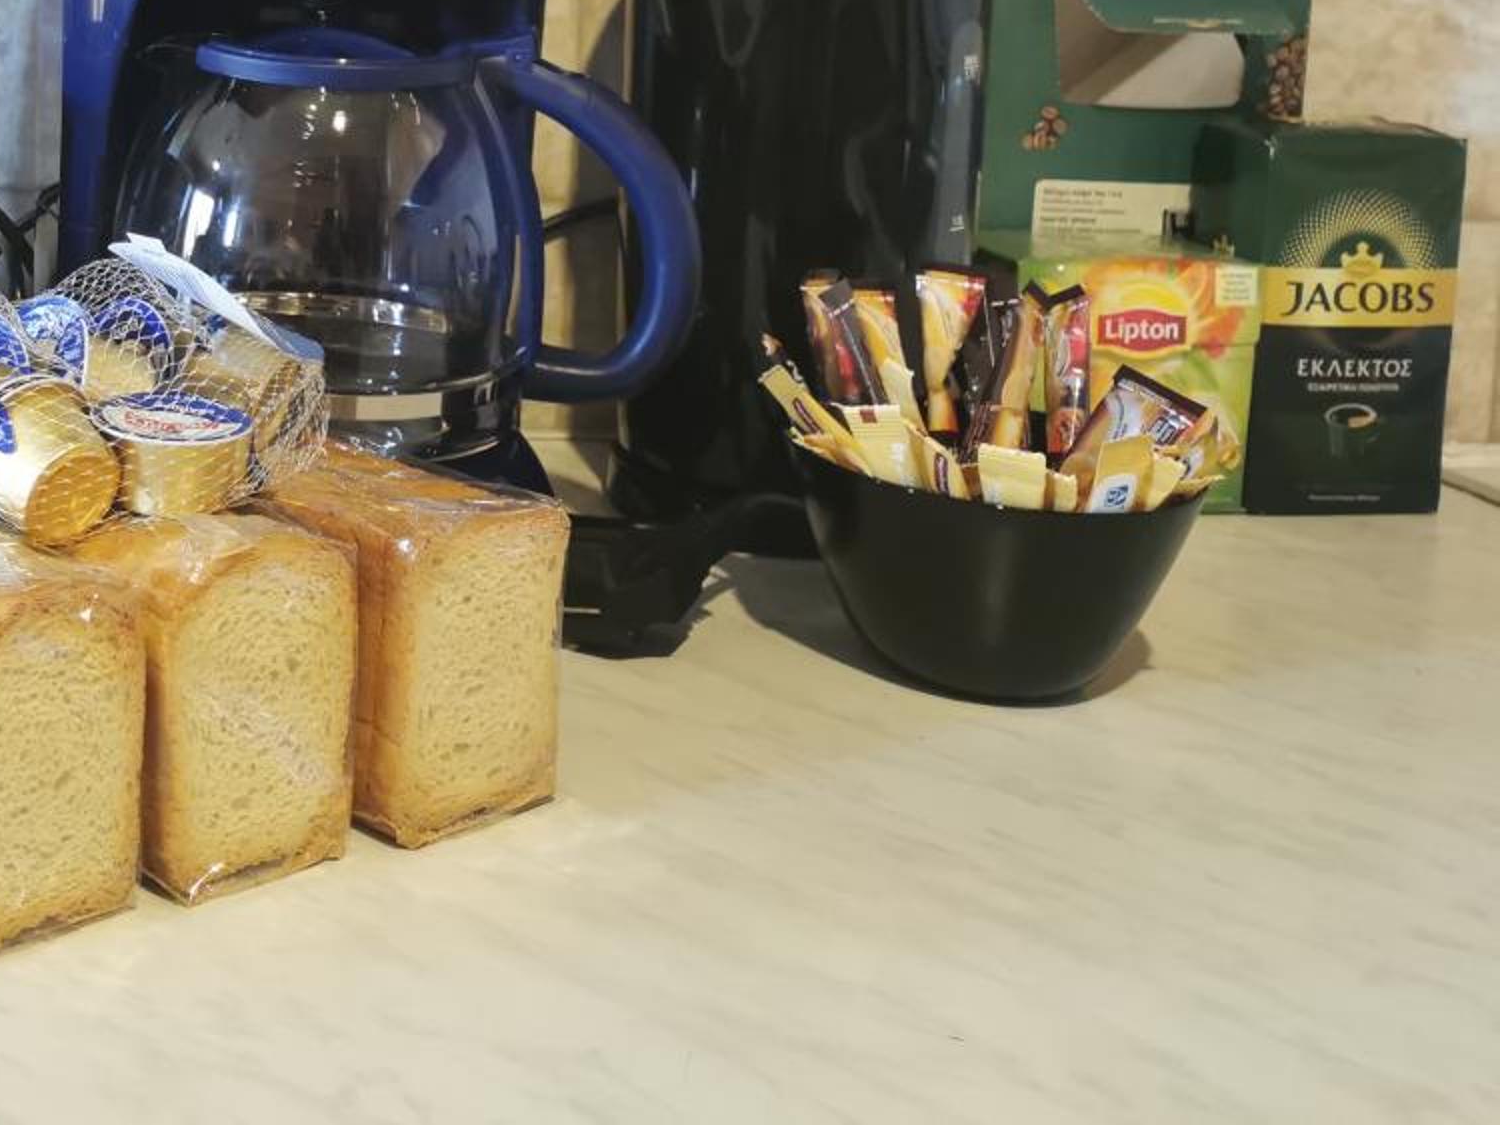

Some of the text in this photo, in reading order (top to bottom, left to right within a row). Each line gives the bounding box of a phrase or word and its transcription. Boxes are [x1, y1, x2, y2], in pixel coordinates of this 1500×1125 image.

[1281, 281, 1435, 316] JACOBS
[1104, 318, 1180, 344] Lipton
[1297, 358, 1413, 377] ΕΚΛΕΚΤΟΣ
